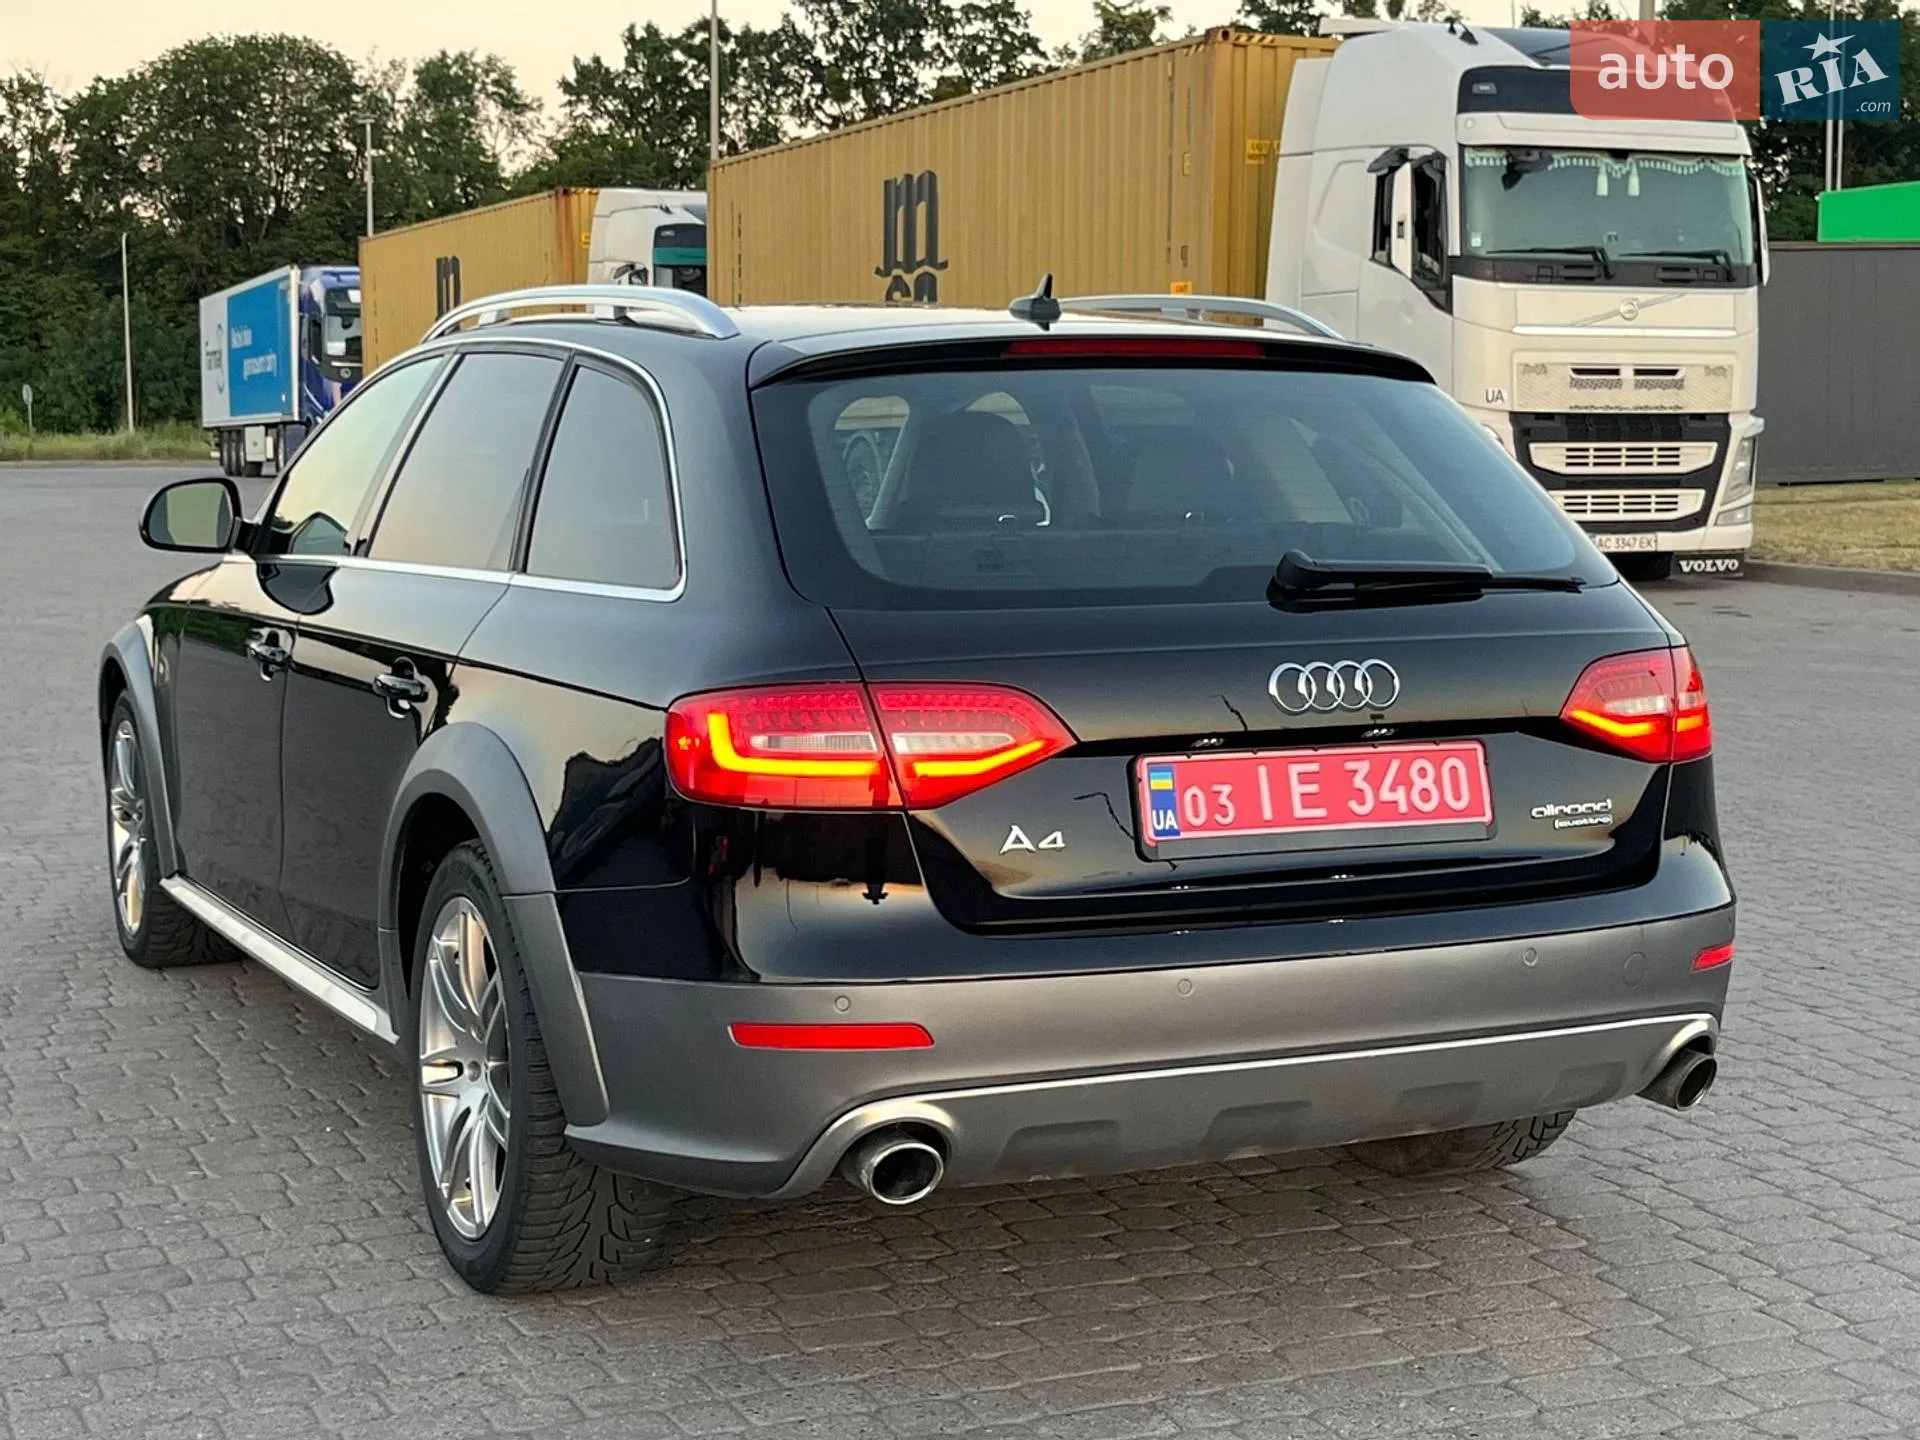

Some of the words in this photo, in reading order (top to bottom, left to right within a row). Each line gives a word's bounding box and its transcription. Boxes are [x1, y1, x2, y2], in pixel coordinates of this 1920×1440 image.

[1485, 389, 1505, 404] UA
[1597, 537, 1612, 550] AC
[1679, 558, 1739, 573] VOLVO
[1183, 783, 1236, 827] 03
[1256, 762, 1328, 821] IE
[1343, 756, 1470, 817] 3480
[1530, 798, 1612, 818] allroad
[1152, 809, 1178, 831] UA
[1000, 824, 1066, 855] A4
